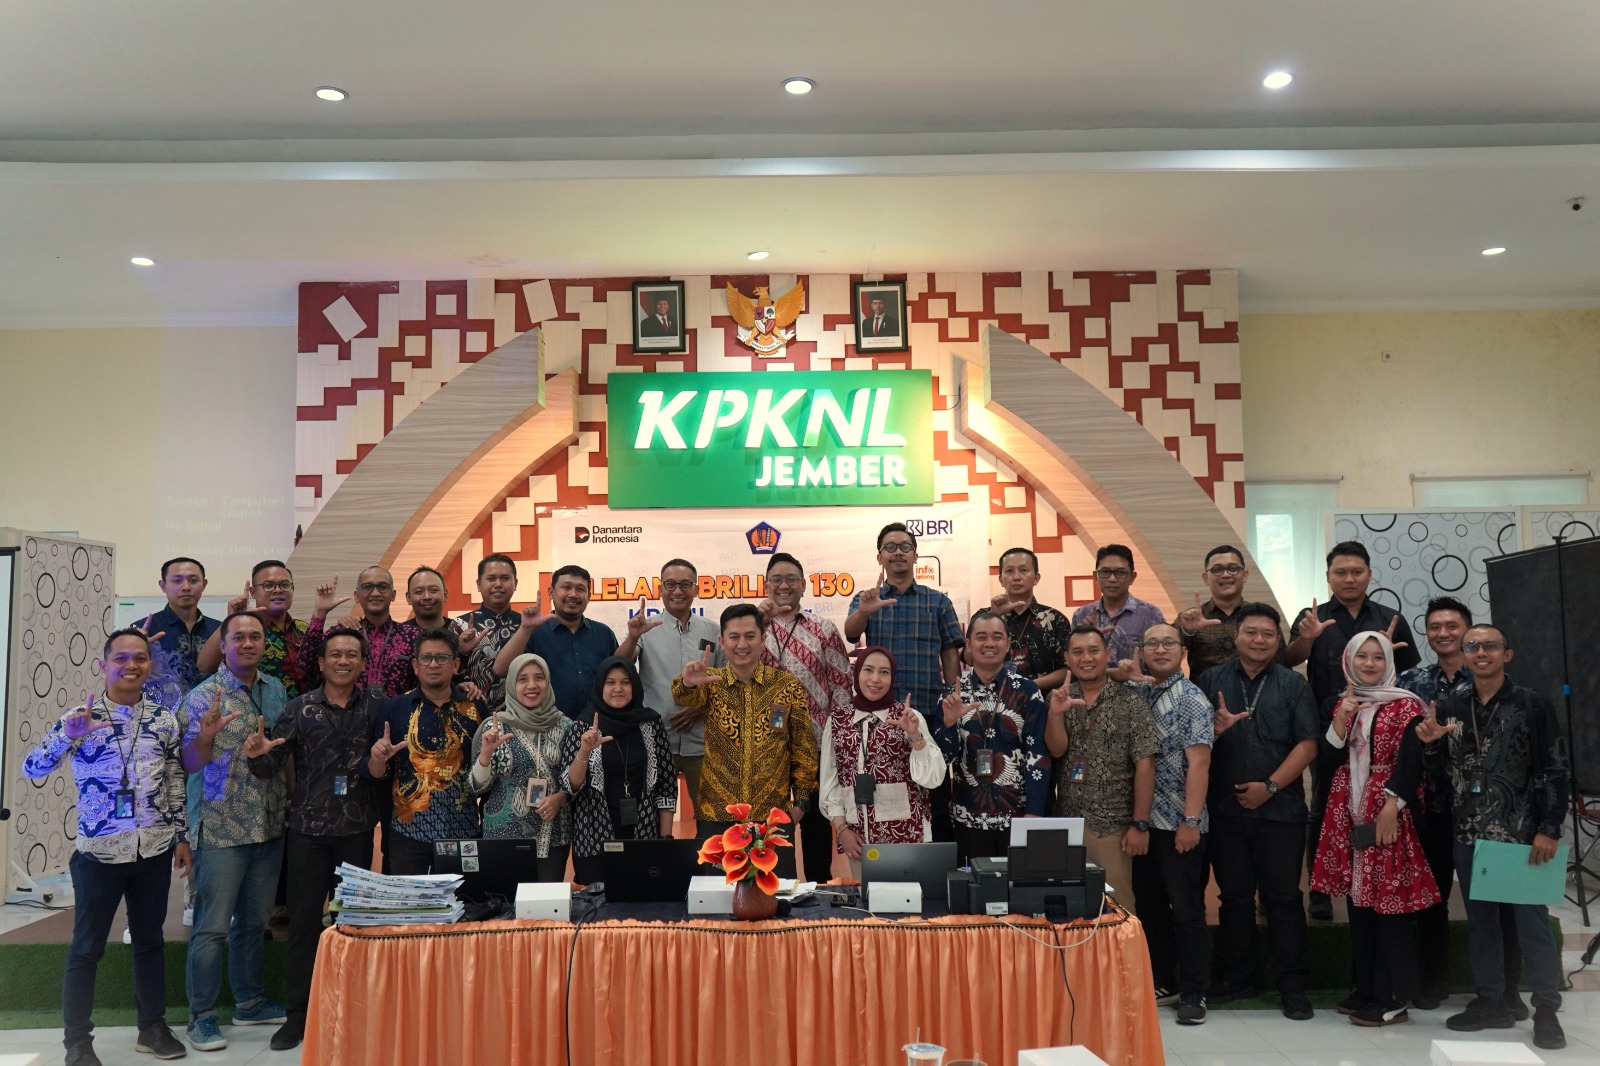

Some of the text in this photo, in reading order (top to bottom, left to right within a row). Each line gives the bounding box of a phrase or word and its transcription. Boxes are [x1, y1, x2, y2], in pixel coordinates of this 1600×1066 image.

[633, 387, 908, 450] KPKNL
[755, 455, 908, 487] JEMBER
[592, 526, 642, 534] Danantara
[926, 520, 953, 535] BRI
[592, 534, 639, 543] Indonesia
[809, 572, 855, 597] 130
[815, 602, 833, 614] BRI
